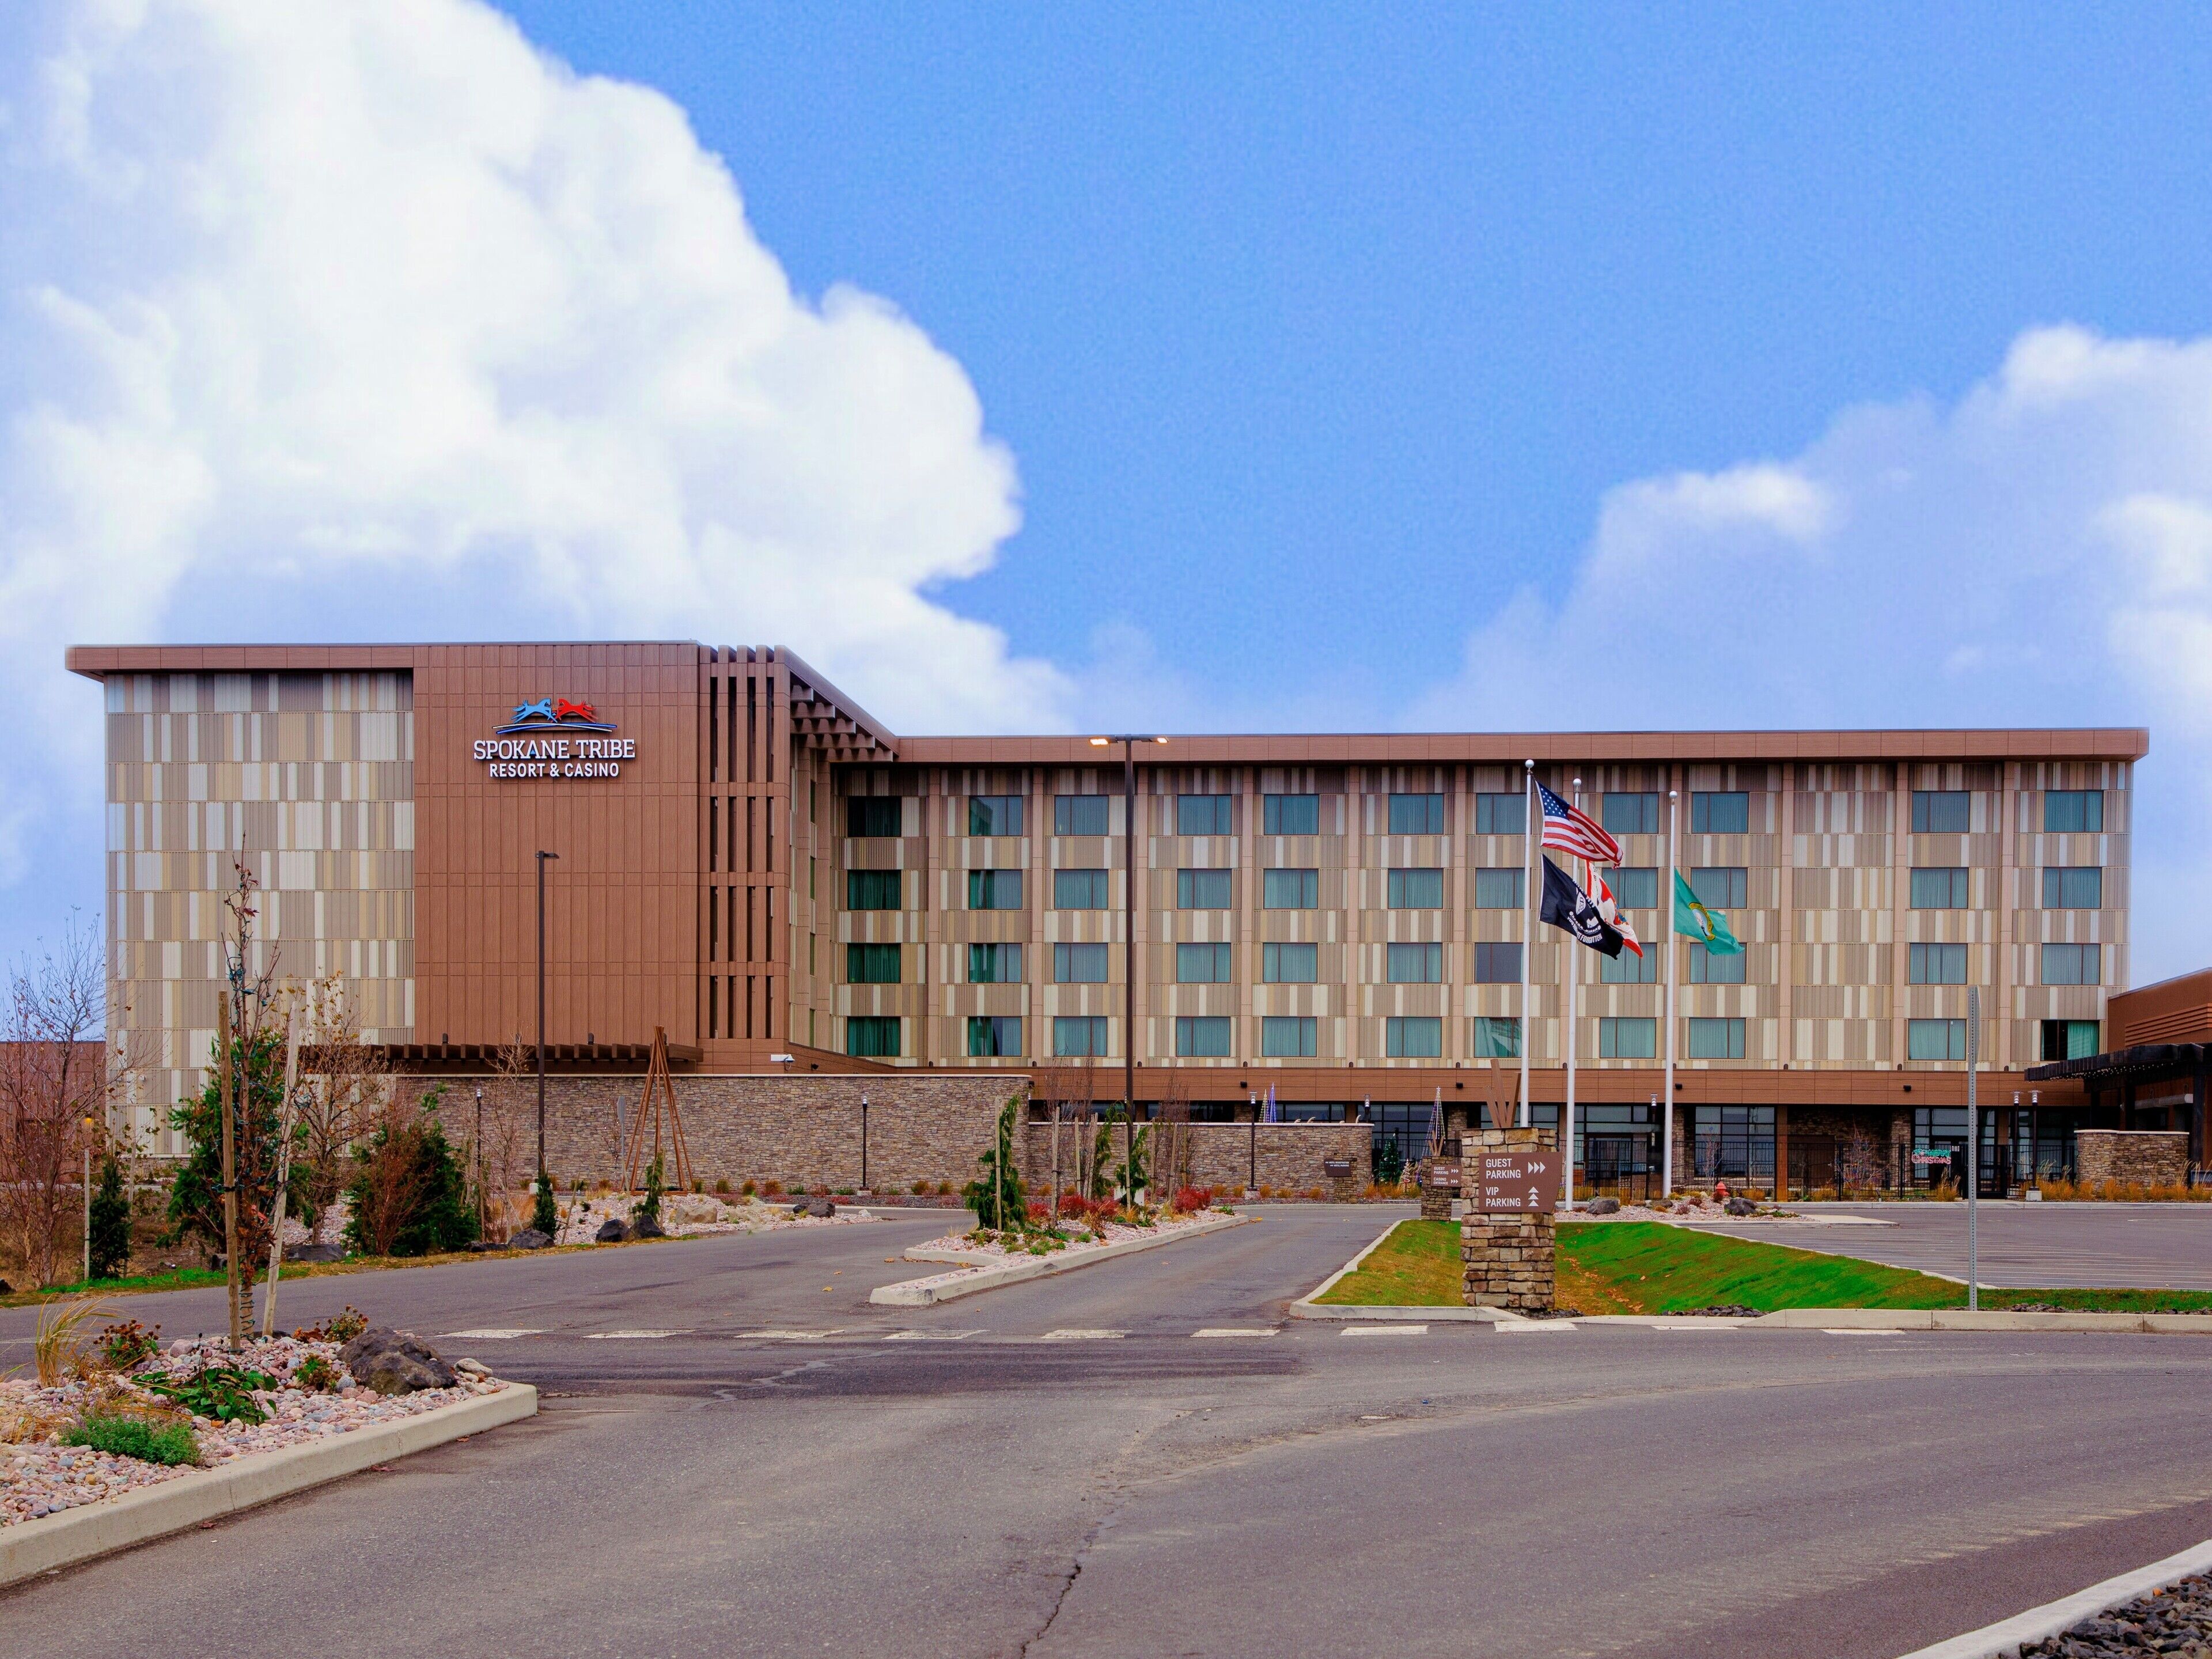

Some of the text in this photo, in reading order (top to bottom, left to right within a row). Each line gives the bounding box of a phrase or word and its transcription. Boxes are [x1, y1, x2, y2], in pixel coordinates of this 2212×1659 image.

[474, 739, 635, 760] SPOKANE TRIBE
[490, 763, 619, 778] RESORT & CASINO
[1486, 1158, 1512, 1168] GUEST
[1486, 1169, 1521, 1179] PARKING
[1486, 1187, 1499, 1195] VIP
[1486, 1198, 1521, 1207] PARKING
